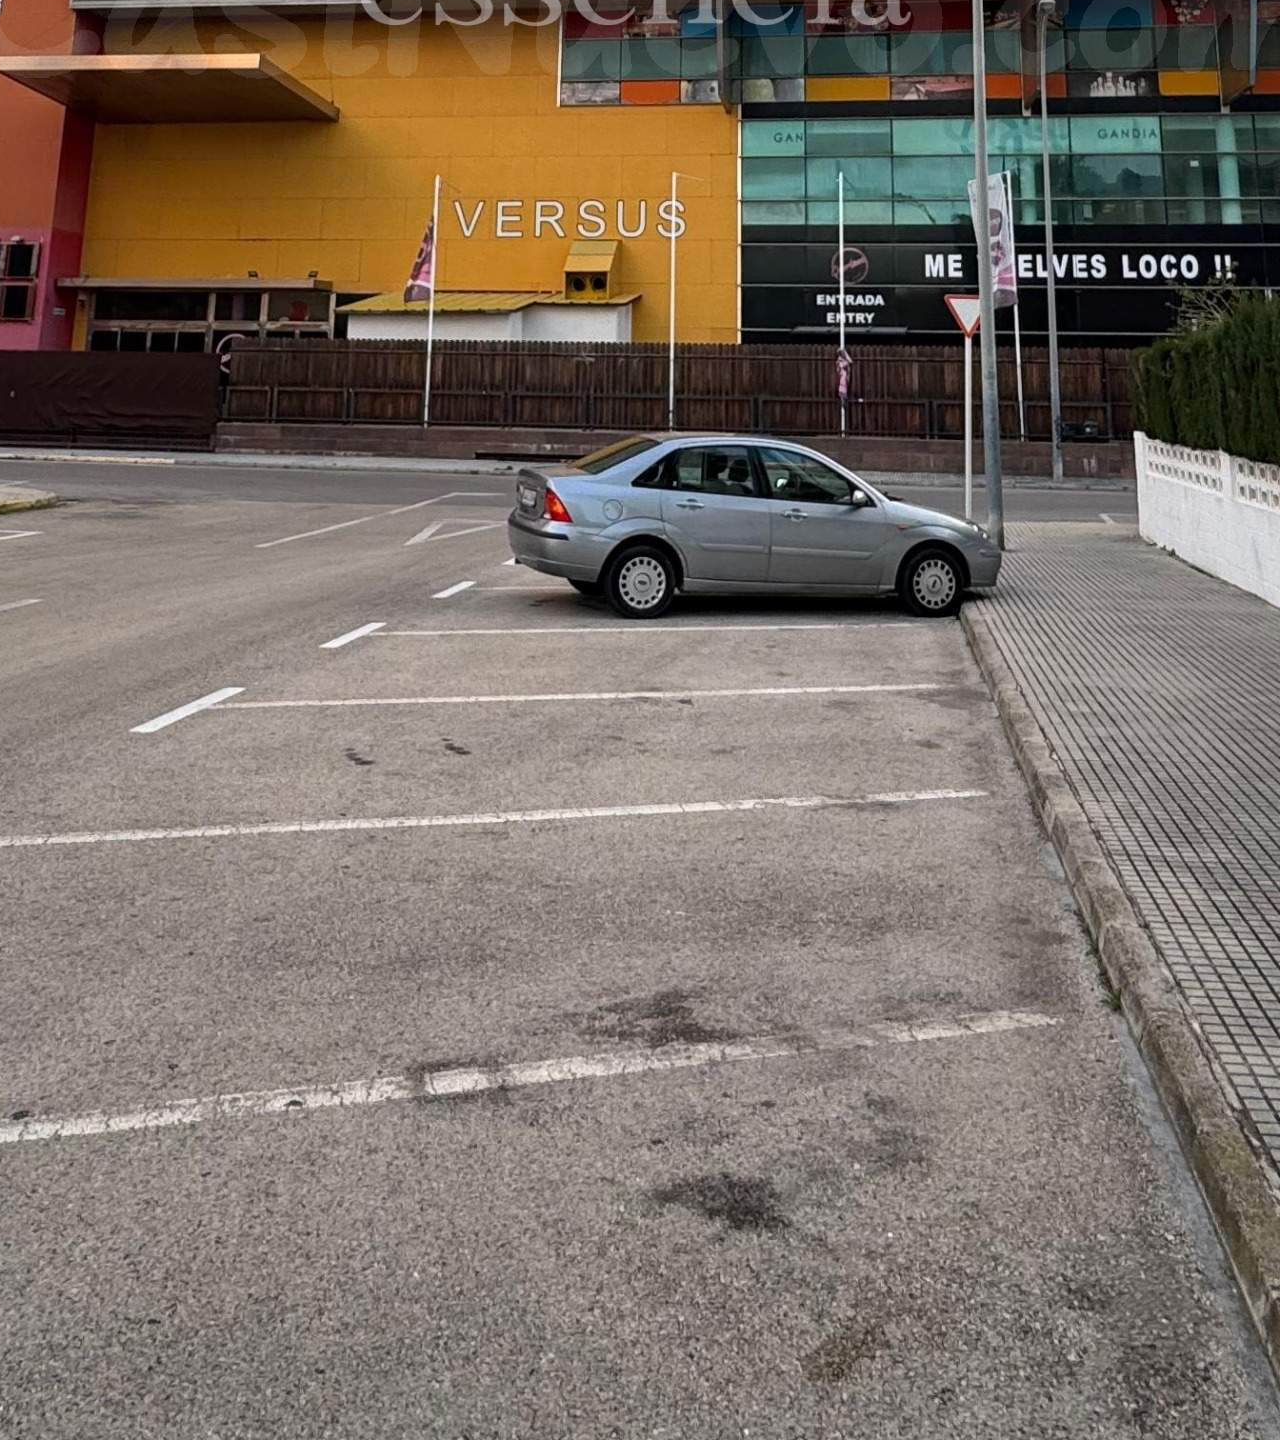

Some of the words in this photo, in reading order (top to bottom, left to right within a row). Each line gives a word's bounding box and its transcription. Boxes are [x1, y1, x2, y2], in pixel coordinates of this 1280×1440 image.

[1097, 127, 1158, 141] GANDIA
[453, 199, 687, 238] VERSUS
[925, 254, 963, 278] ME
[978, 254, 1107, 278] ELVES
[1122, 254, 1199, 278] LOCO
[816, 294, 885, 306] ENTRADA
[826, 312, 875, 323] ENTRY
